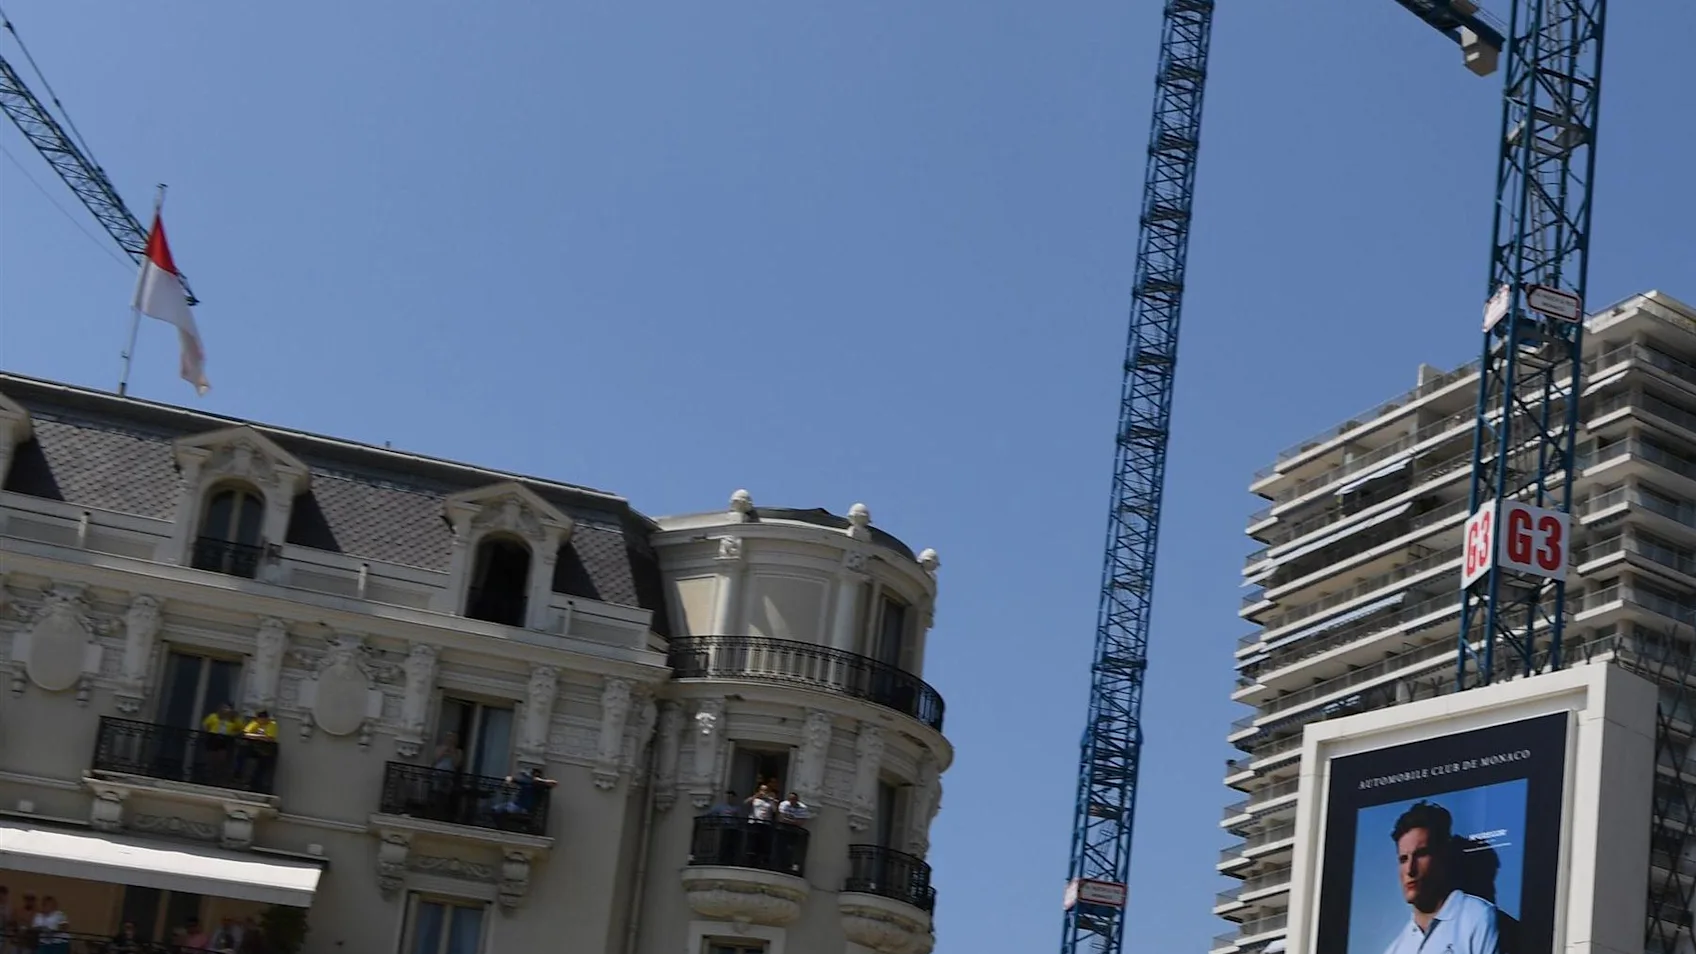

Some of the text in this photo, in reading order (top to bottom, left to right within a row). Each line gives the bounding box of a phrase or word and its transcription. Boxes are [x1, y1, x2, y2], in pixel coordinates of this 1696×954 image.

[1466, 510, 1491, 578] G3
[1507, 508, 1562, 572] G3
[1357, 749, 1531, 790] AUTOMOBILE CLUB DE MONACO
